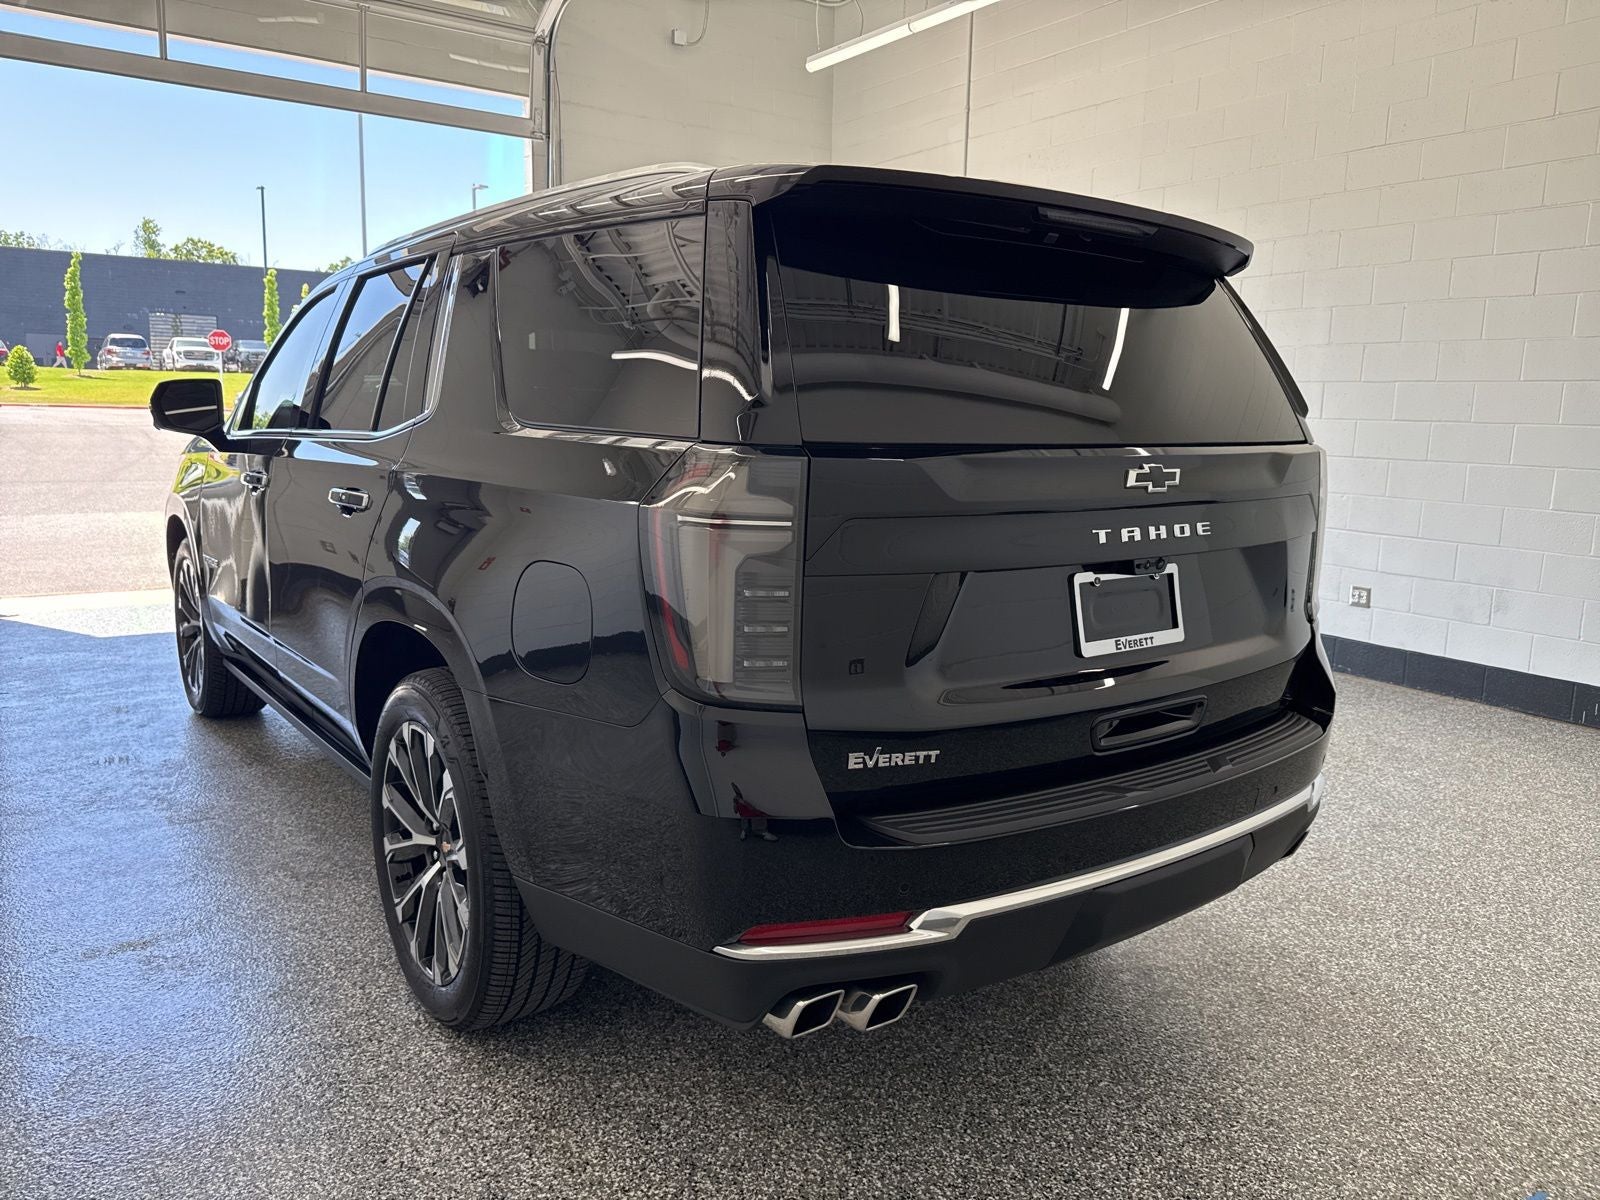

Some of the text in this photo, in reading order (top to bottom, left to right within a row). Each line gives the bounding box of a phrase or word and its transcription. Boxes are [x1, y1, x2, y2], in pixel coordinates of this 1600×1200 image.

[209, 336, 230, 345] STOP
[1092, 521, 1211, 544] TAHOE
[1114, 636, 1154, 651] EVERETT
[847, 746, 940, 769] EVERETT
